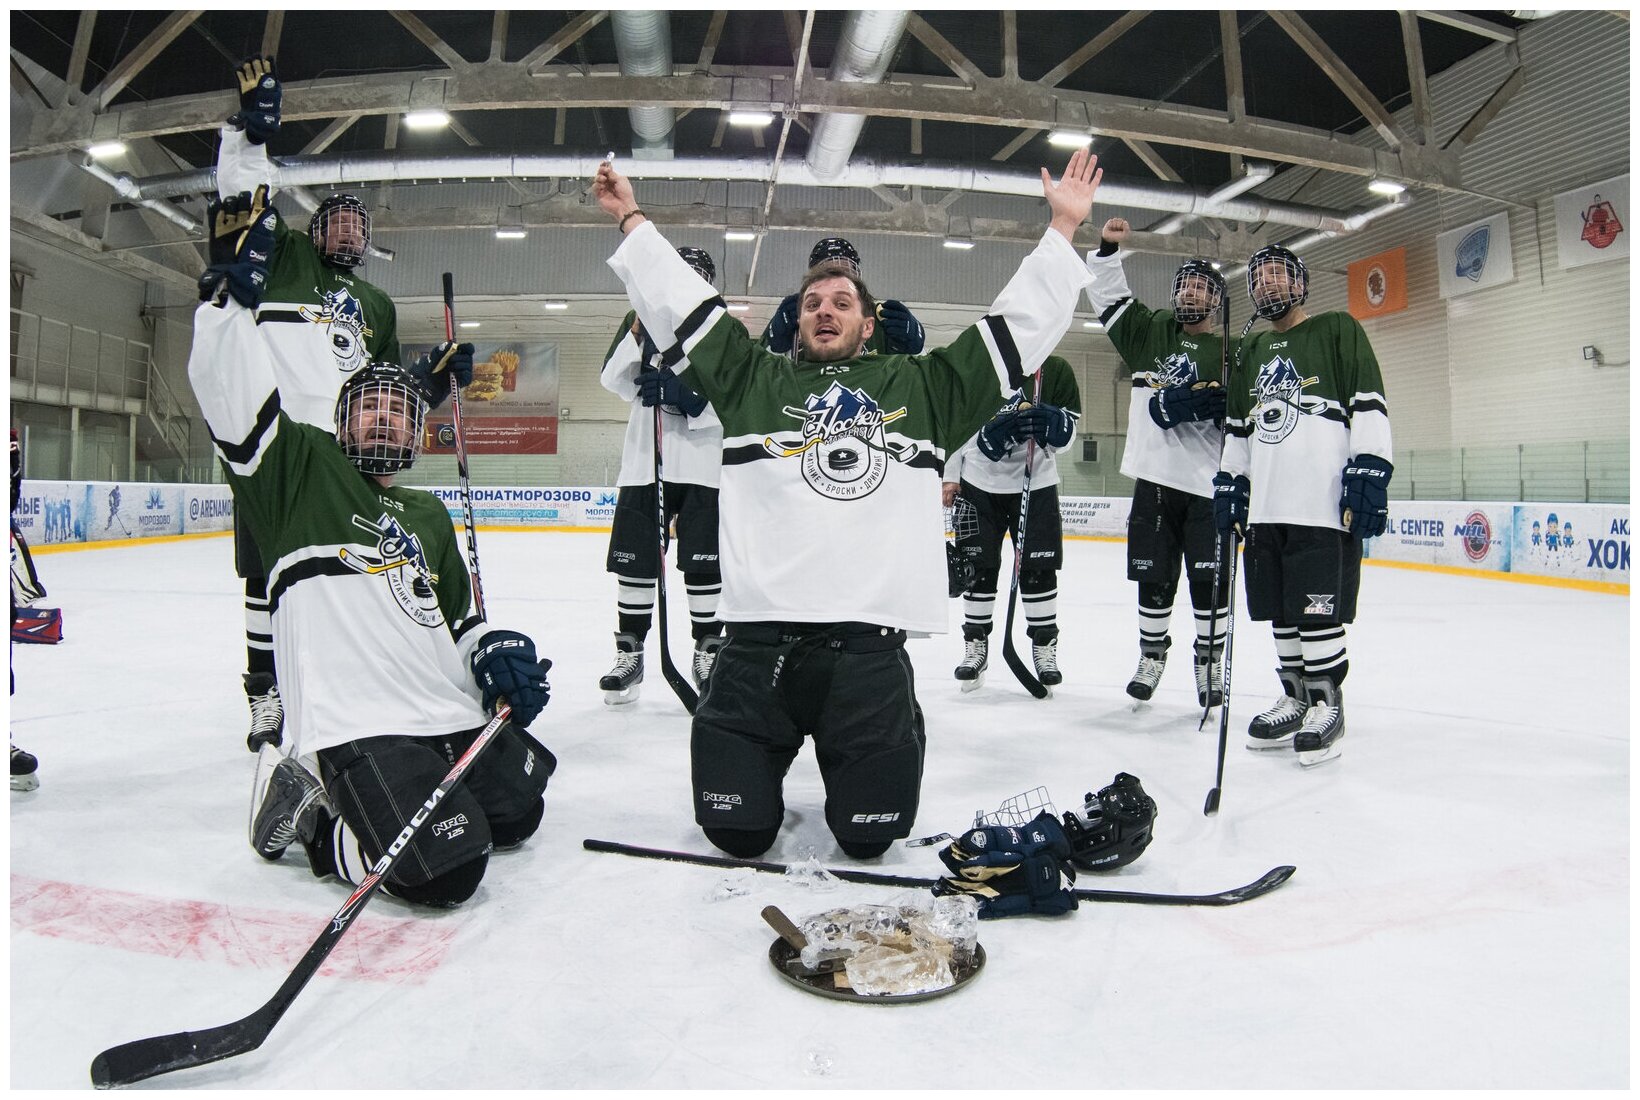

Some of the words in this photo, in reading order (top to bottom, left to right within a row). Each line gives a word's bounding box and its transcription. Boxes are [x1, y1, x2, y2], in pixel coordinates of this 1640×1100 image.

[806, 405, 883, 441] Hockey
[1346, 467, 1386, 478] EFSI
[430, 489, 591, 502] ЕМПОНАТМОРОЗОВО
[826, 482, 858, 496] БРОСКИ
[190, 498, 234, 521] @ARENAMO
[139, 514, 171, 526] МОРОЗОВО
[1401, 519, 1444, 537] CENTER
[1610, 518, 1630, 535] АК
[1030, 551, 1055, 559] EFSI
[474, 640, 525, 666] EFSI
[481, 715, 502, 739] 5000
[523, 748, 535, 776] EFS
[702, 792, 742, 805] NRG
[711, 803, 733, 811] 125
[431, 813, 469, 837] NRG
[851, 812, 901, 824] EFSI
[447, 827, 466, 846] 125
